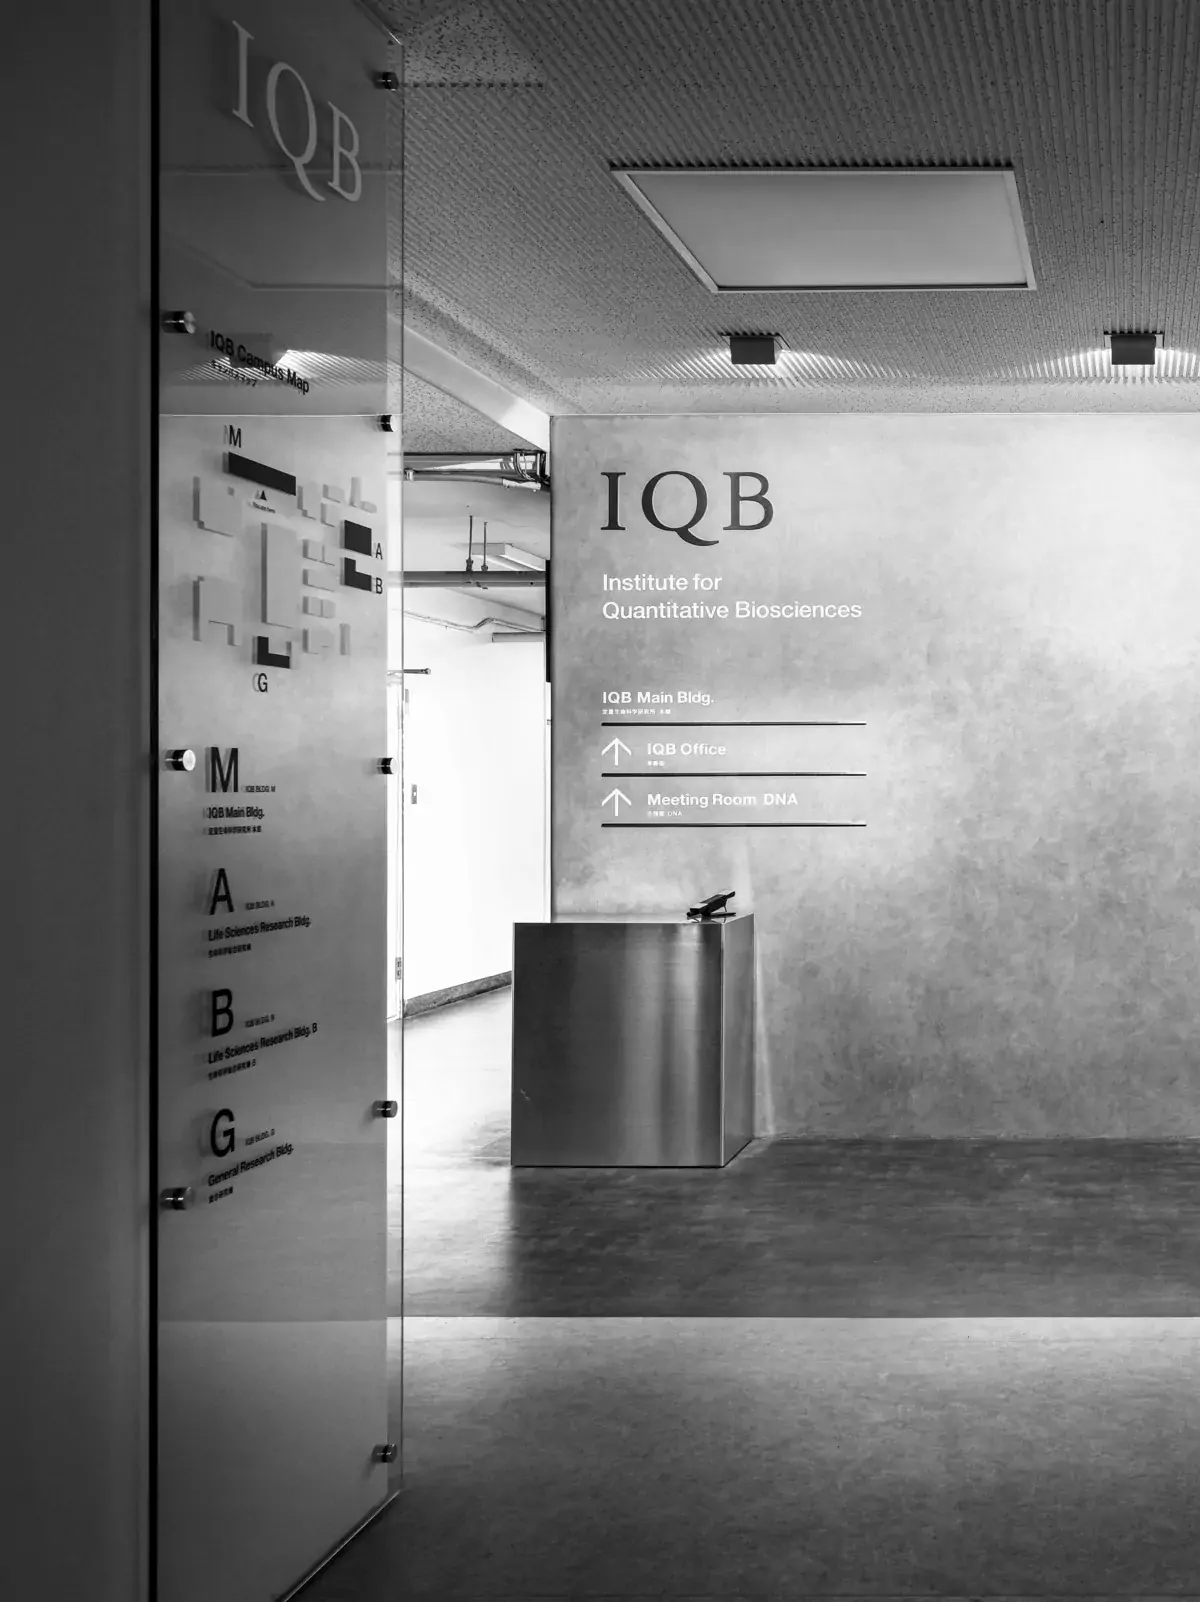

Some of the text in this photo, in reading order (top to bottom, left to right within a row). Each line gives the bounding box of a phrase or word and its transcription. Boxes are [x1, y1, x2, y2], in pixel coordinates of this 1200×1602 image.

[232, 20, 362, 202] IQB
[210, 330, 309, 395] IQB Campus Map
[228, 424, 242, 448] M
[600, 470, 774, 547] IQB
[375, 542, 383, 560] A
[375, 578, 383, 594] B
[602, 573, 723, 591] Institute for
[602, 601, 862, 620] Quantitative Biosciences
[257, 672, 268, 692] G
[602, 691, 715, 706] IQB Main Bldg.
[648, 742, 726, 756] IQB Office
[210, 746, 238, 792] M
[208, 806, 265, 820] IQB Main Bldg.
[648, 793, 799, 808] Meeting Room DNA
[209, 868, 234, 915] A
[208, 915, 312, 942] Life Sciences Research Bldg.
[211, 988, 234, 1037] B
[208, 1022, 318, 1064] Life Sciences Research Bldg. B
[210, 1108, 236, 1158] G
[208, 1143, 294, 1187] General Research Bldg.
